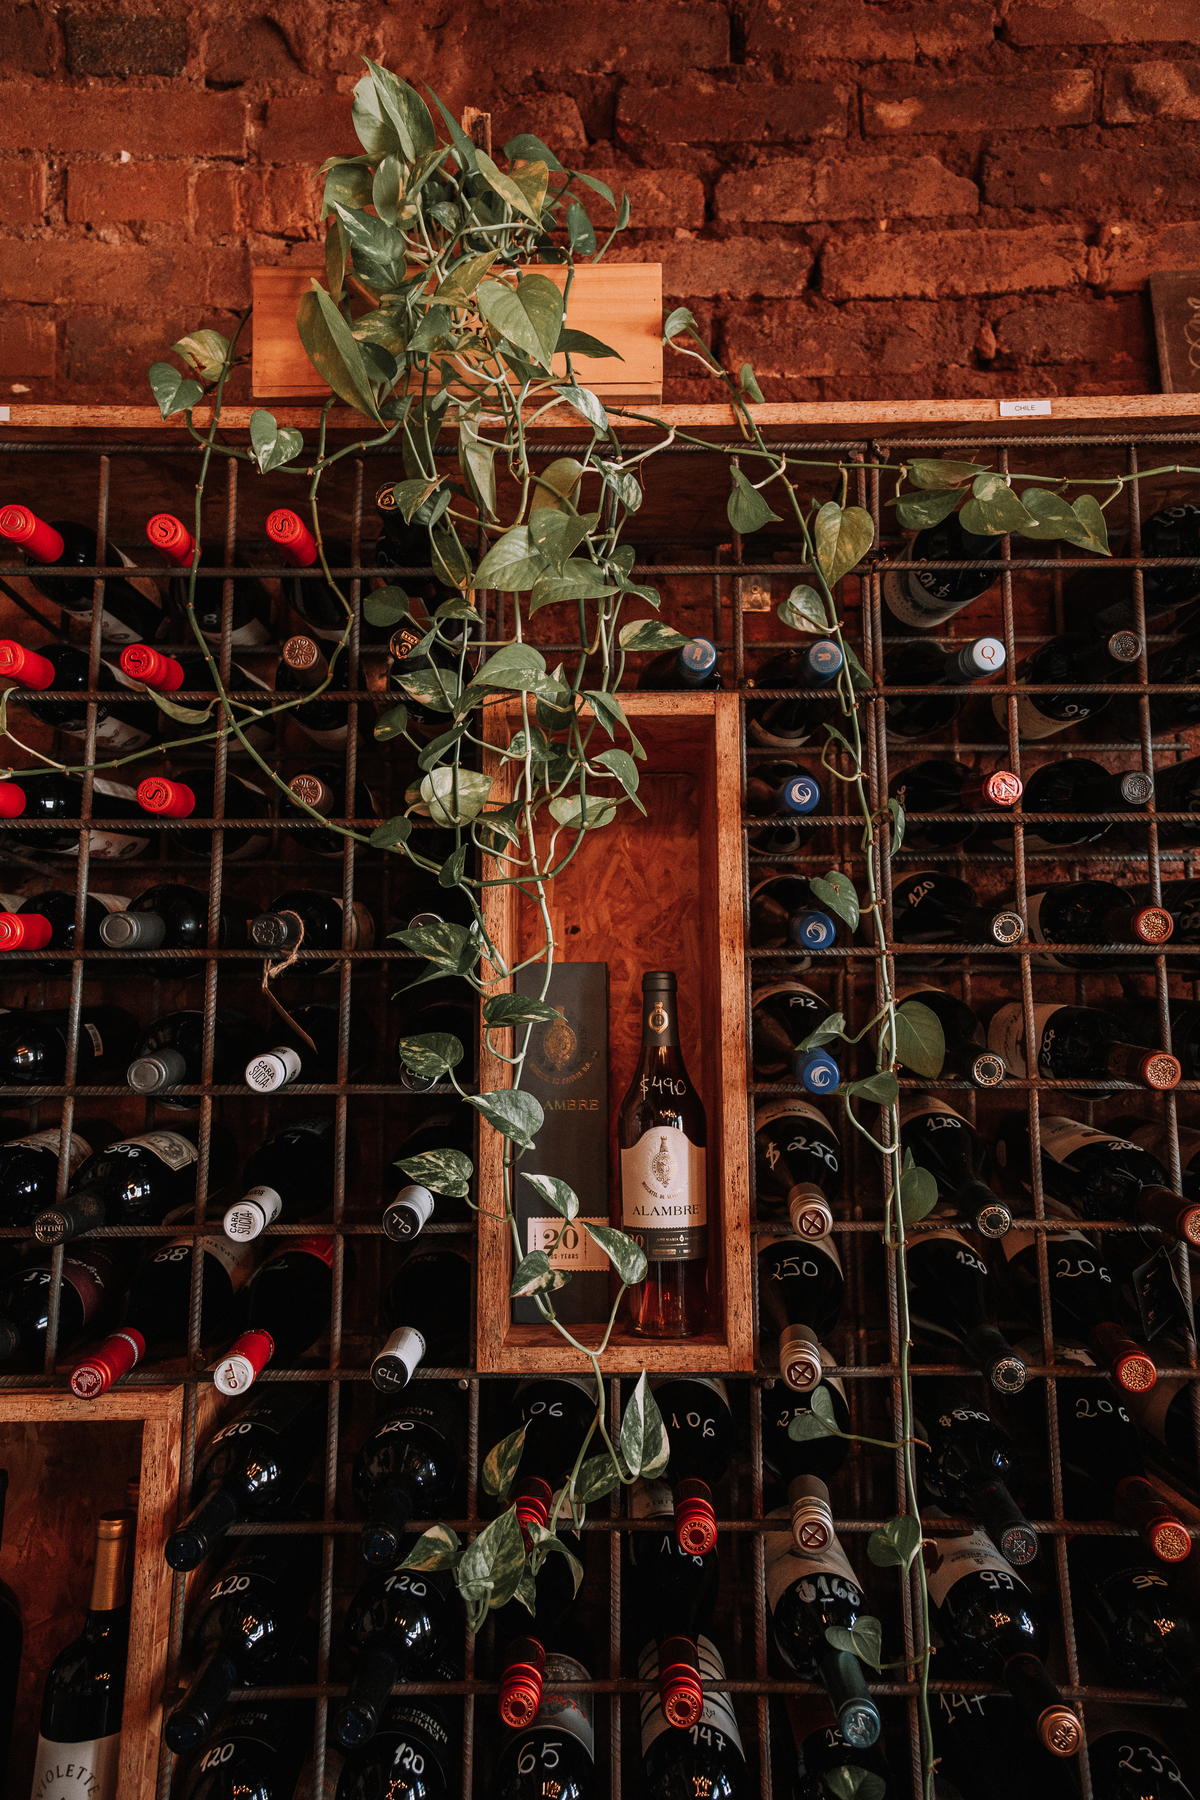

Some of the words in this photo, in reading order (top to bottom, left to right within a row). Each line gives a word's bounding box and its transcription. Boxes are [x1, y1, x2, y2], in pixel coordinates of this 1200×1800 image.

[1014, 404, 1036, 412] CHILE
[157, 521, 169, 538] S
[274, 518, 291, 533] S
[129, 652, 144, 669] S
[980, 645, 995, 666] Q
[145, 788, 162, 800] S
[908, 880, 936, 908] 120
[258, 1060, 275, 1080] CARA
[640, 1073, 687, 1101] $490
[926, 1117, 962, 1132] 120
[632, 1204, 700, 1217] ALAMBRE
[229, 1211, 240, 1235] CARA
[392, 1212, 412, 1236] CLL
[543, 1228, 579, 1250] 20
[770, 1256, 819, 1281] 250
[956, 1250, 989, 1275] 120
[1056, 1258, 1112, 1283] 206
[224, 1363, 238, 1389] CLL
[377, 1367, 401, 1384] CLL
[1075, 1398, 1131, 1423] 206
[212, 1422, 252, 1444] 120
[375, 1420, 416, 1439] 120
[671, 1412, 716, 1438] 106
[210, 1575, 251, 1600] 120
[384, 1575, 428, 1597] 120
[979, 1570, 1015, 1591] 99
[689, 1724, 727, 1751] 147
[201, 1742, 236, 1773] 120
[393, 1742, 426, 1775] 120
[517, 1741, 563, 1775] 65
[36, 1763, 101, 1798] VIOLETTE
